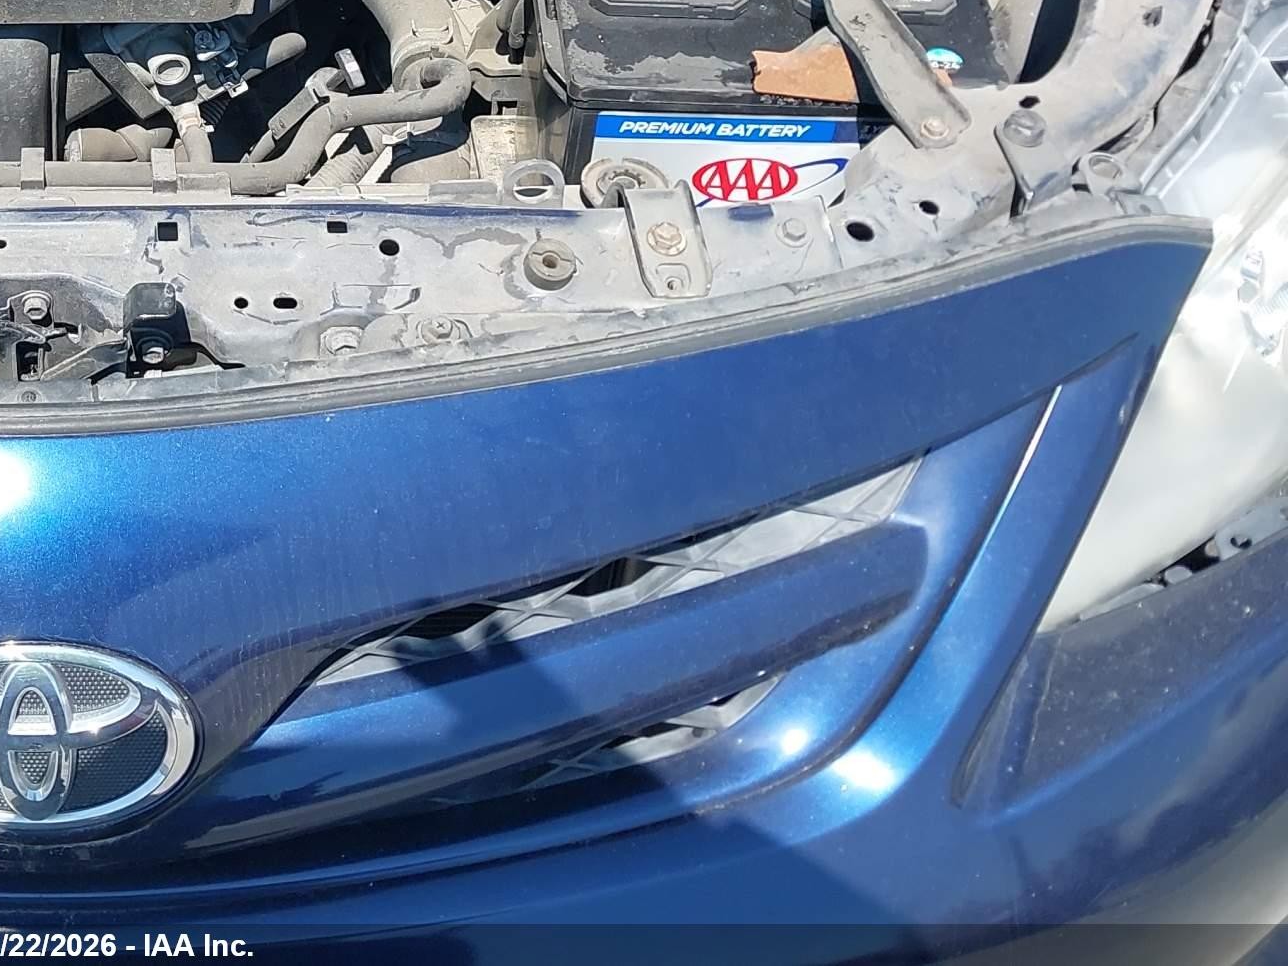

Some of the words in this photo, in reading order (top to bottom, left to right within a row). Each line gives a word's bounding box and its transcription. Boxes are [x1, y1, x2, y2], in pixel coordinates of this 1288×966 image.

[619, 120, 714, 136] PREMIUM
[716, 122, 812, 138] BATTERY
[697, 159, 792, 201] AAA
